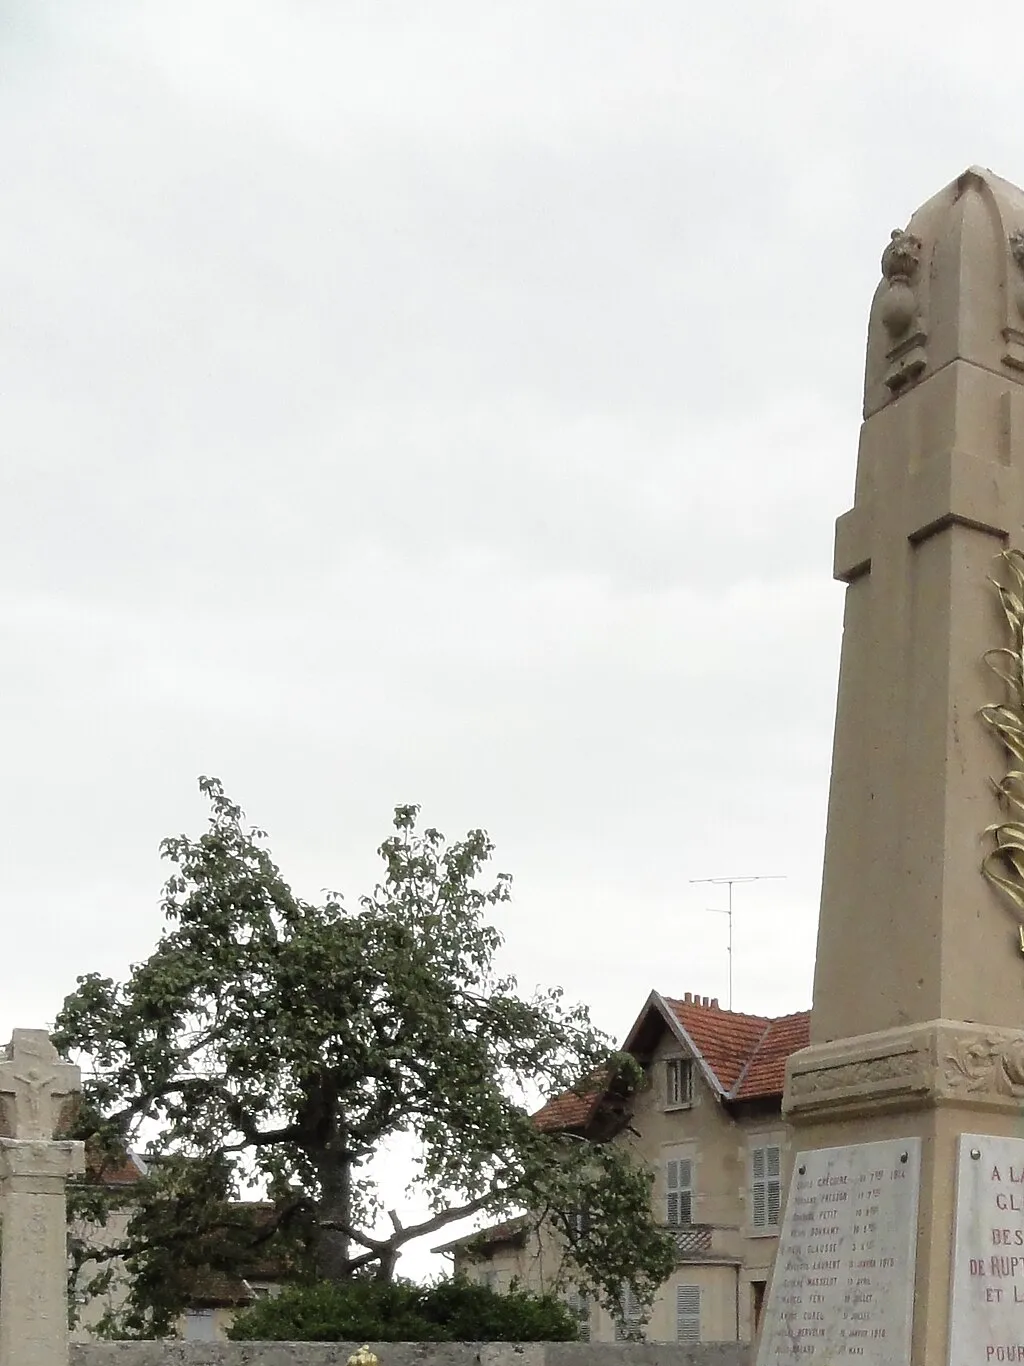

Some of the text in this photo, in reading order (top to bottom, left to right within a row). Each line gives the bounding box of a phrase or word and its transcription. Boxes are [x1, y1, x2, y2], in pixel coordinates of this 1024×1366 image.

[991, 1166, 1001, 1182] A
[992, 1228, 1024, 1246] DES
[969, 1259, 985, 1276] DE
[986, 1288, 1003, 1303] ET
